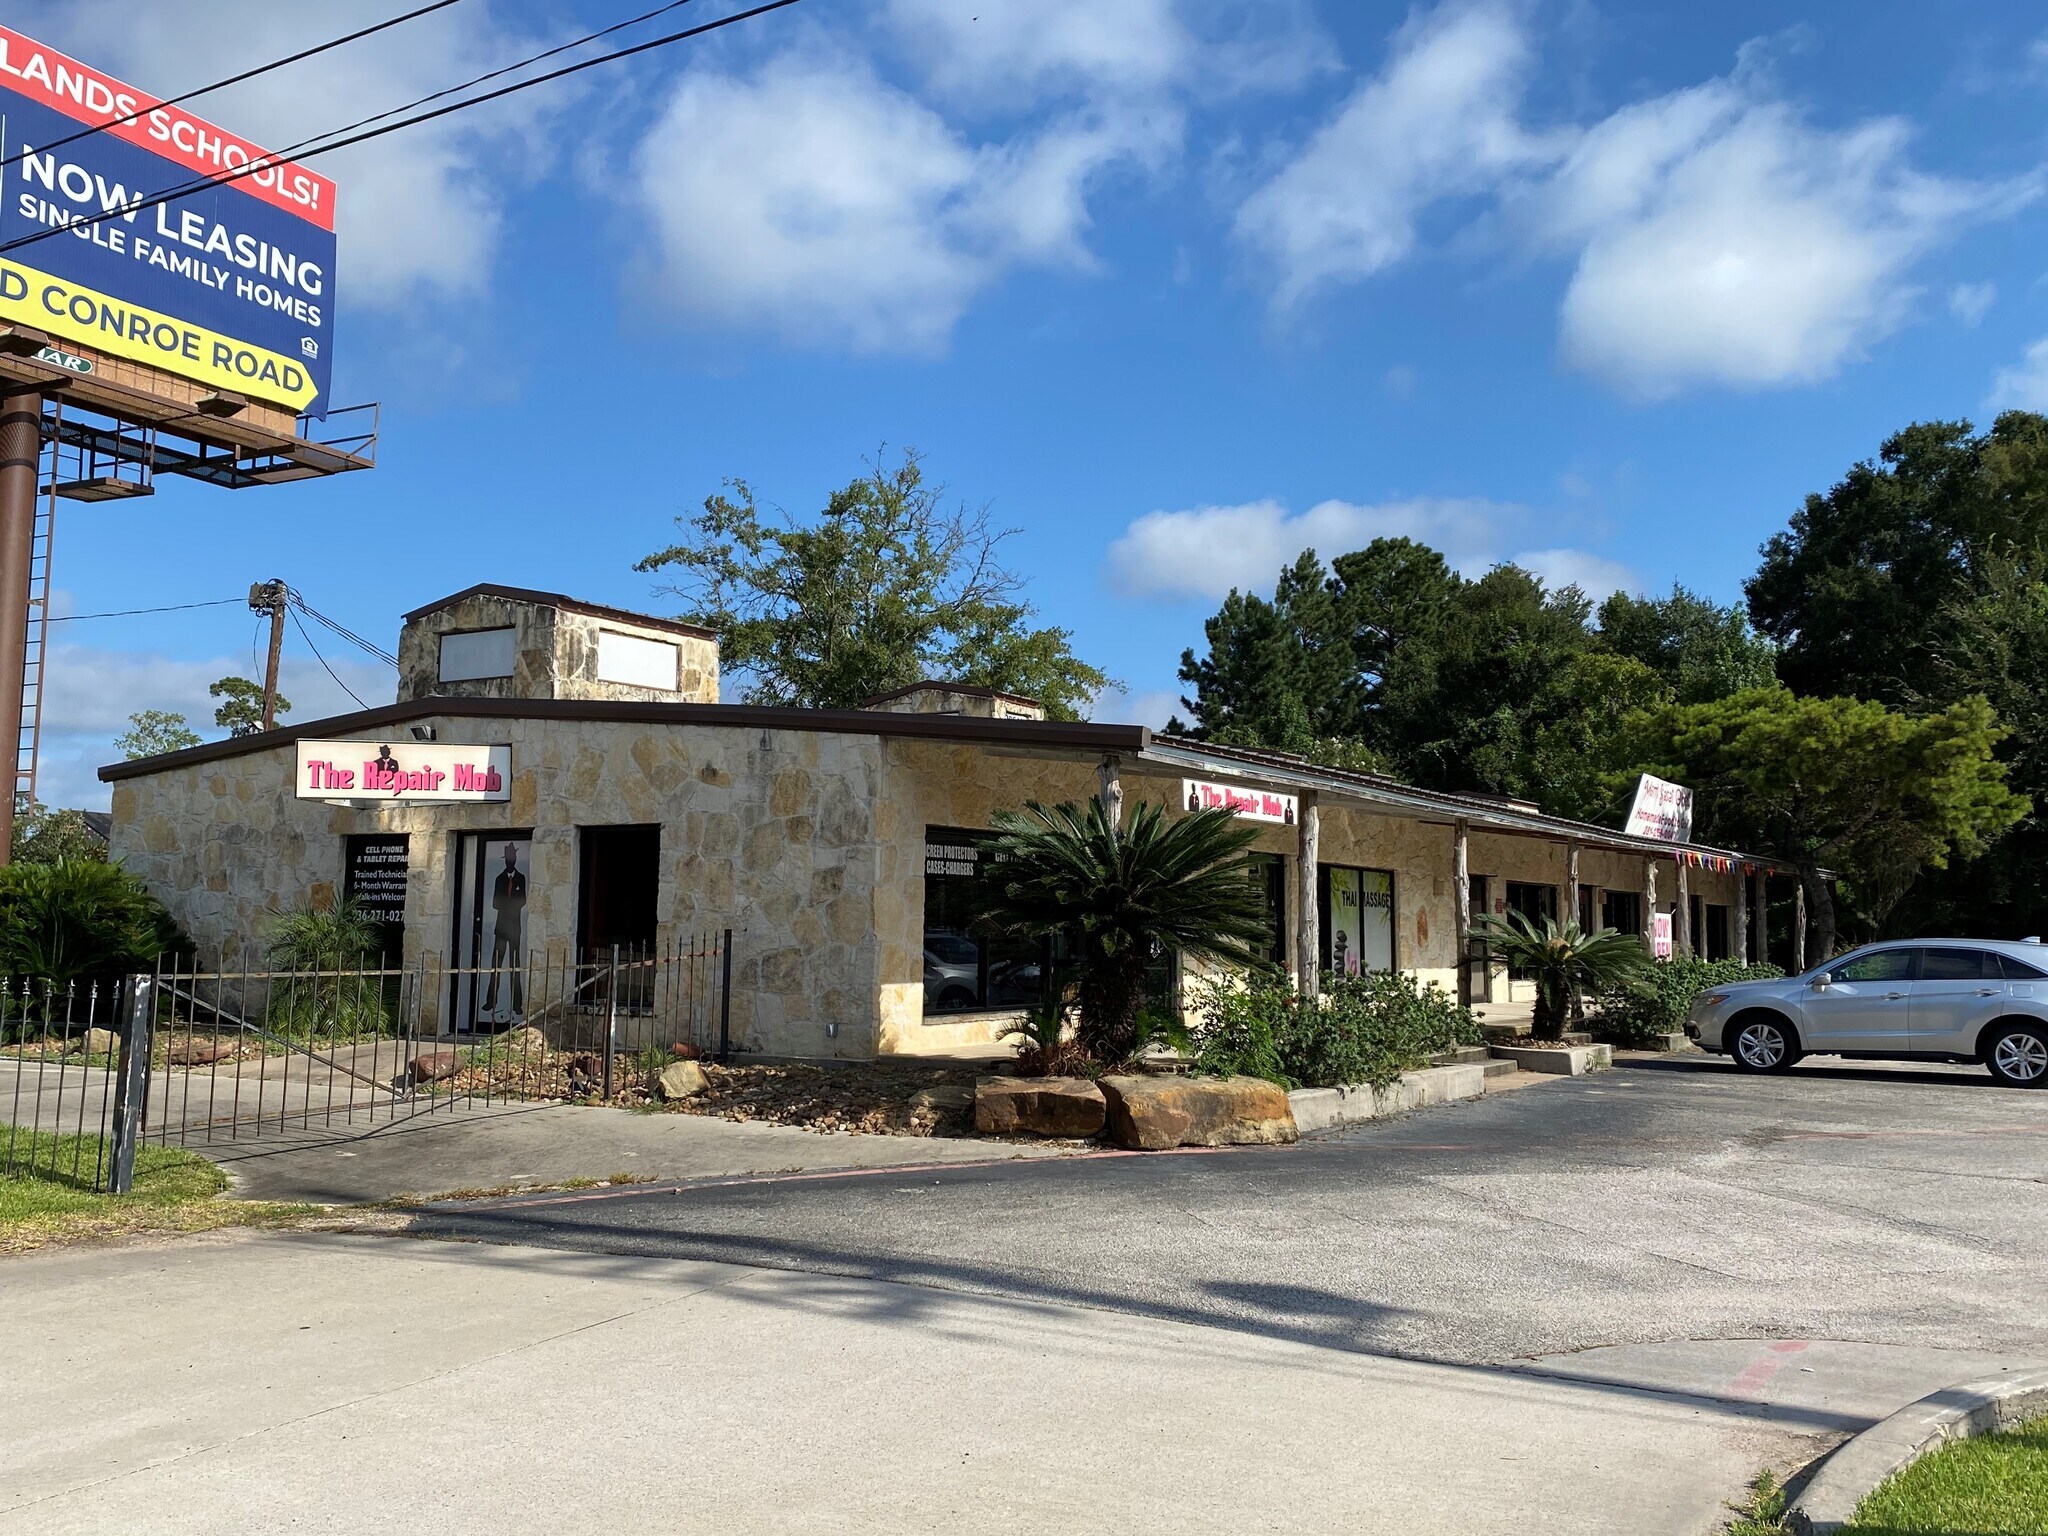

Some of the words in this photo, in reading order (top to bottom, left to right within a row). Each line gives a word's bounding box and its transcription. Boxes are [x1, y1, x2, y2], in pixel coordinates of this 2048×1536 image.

[0, 36, 138, 127] LANDS
[148, 108, 319, 210] SCHOOLS!
[22, 144, 143, 223] NOW
[156, 201, 322, 296] LEASING
[19, 193, 126, 254] SINGLE
[134, 237, 230, 291] FAMILY
[236, 276, 321, 328] HOMES
[42, 285, 201, 361] CONROE
[212, 340, 304, 392] ROAD
[307, 760, 354, 789] The
[362, 761, 446, 797] Repair
[452, 763, 502, 792] Mob
[1201, 785, 1222, 809] The
[1262, 794, 1283, 817] Mob
[365, 846, 380, 854] CELL
[381, 846, 404, 854] PHONE
[944, 844, 978, 861] PROTECTORS
[357, 855, 362, 863] &
[363, 855, 387, 863] TABLET
[354, 870, 377, 878] Trained
[926, 860, 974, 876] CASES-CHARGERS
[361, 881, 381, 889] Month
[1342, 890, 1357, 907] THAI
